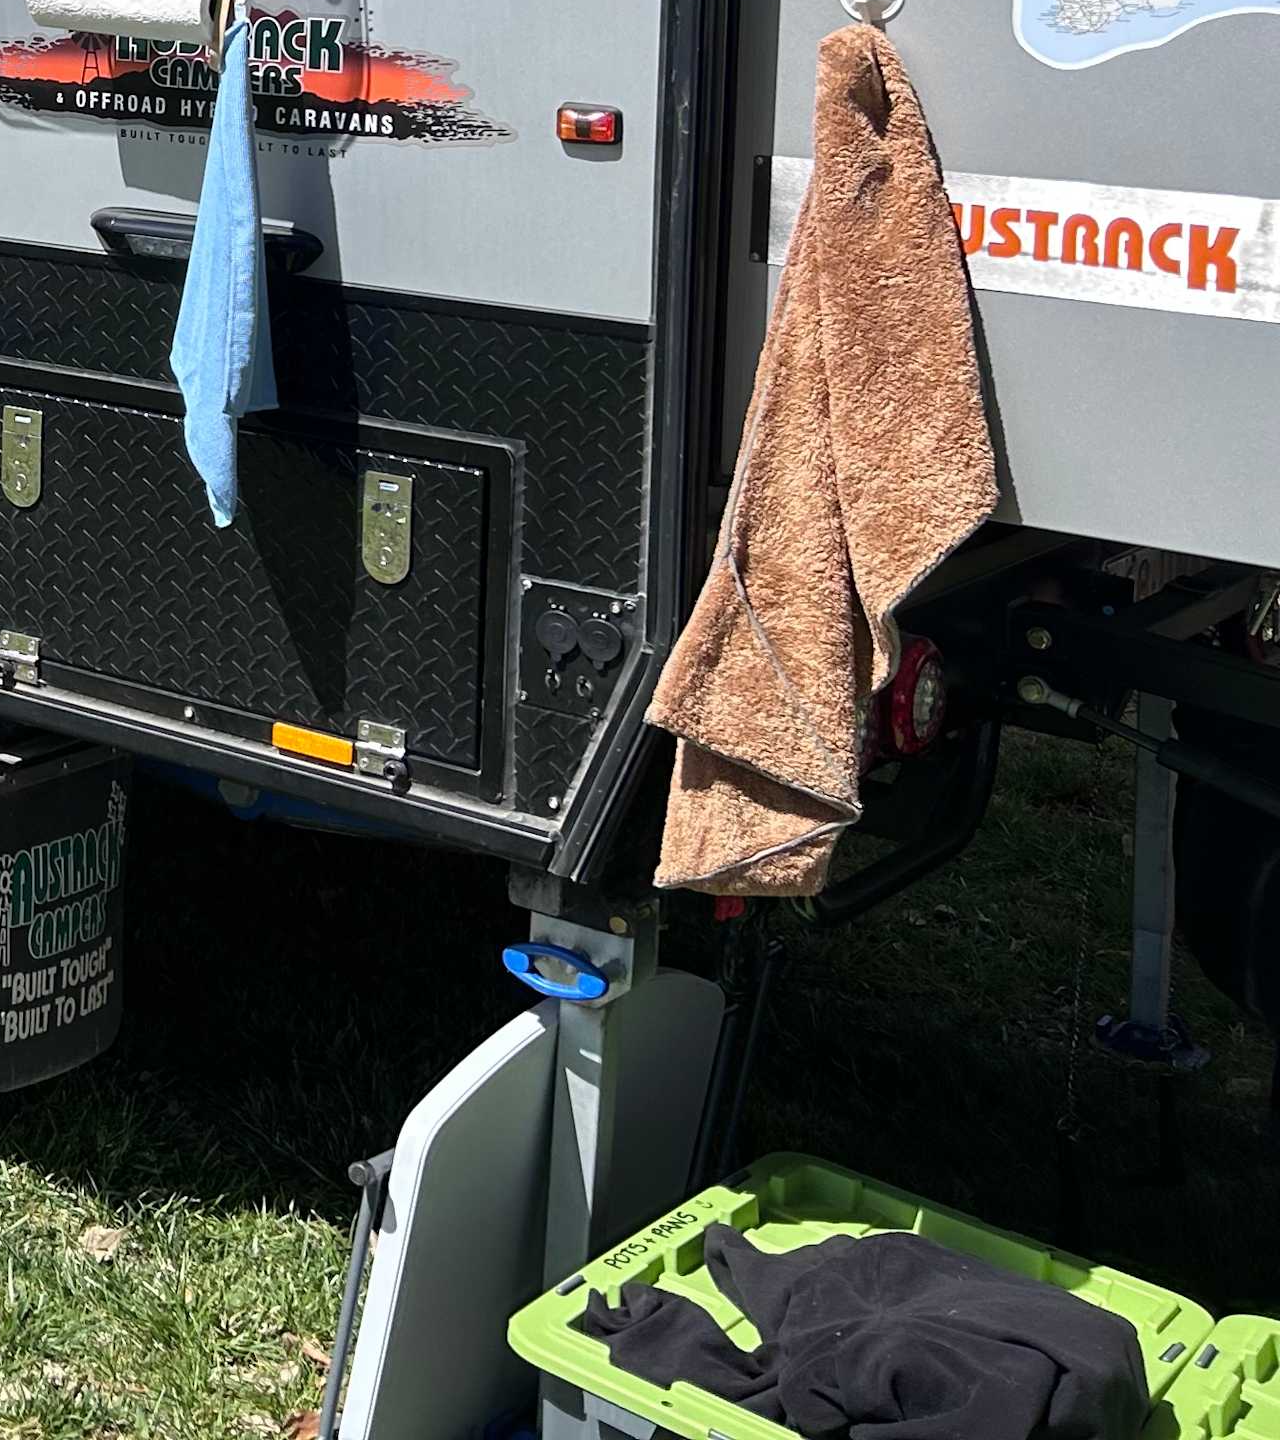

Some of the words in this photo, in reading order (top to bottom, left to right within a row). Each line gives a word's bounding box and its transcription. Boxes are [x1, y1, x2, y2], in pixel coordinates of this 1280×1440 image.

[149, 55, 304, 98] CAMERS
[56, 91, 65, 105] &
[75, 89, 167, 116] OFFROAD
[275, 106, 395, 136] CARAVANS
[120, 128, 161, 142] BUILT
[168, 133, 206, 147] TOUG
[282, 143, 301, 156] TO
[307, 146, 348, 160] LAST
[950, 202, 1241, 294] USTRACK
[7, 818, 120, 930] AUSTRACK
[27, 890, 107, 960] CAMPERS
[1, 965, 58, 1006] "BUILT
[59, 935, 113, 990] TOUGH"
[54, 994, 77, 1028] TO
[78, 969, 115, 1018] LAST"
[603, 1241, 649, 1270] POTS
[650, 1210, 699, 1239] PANS
